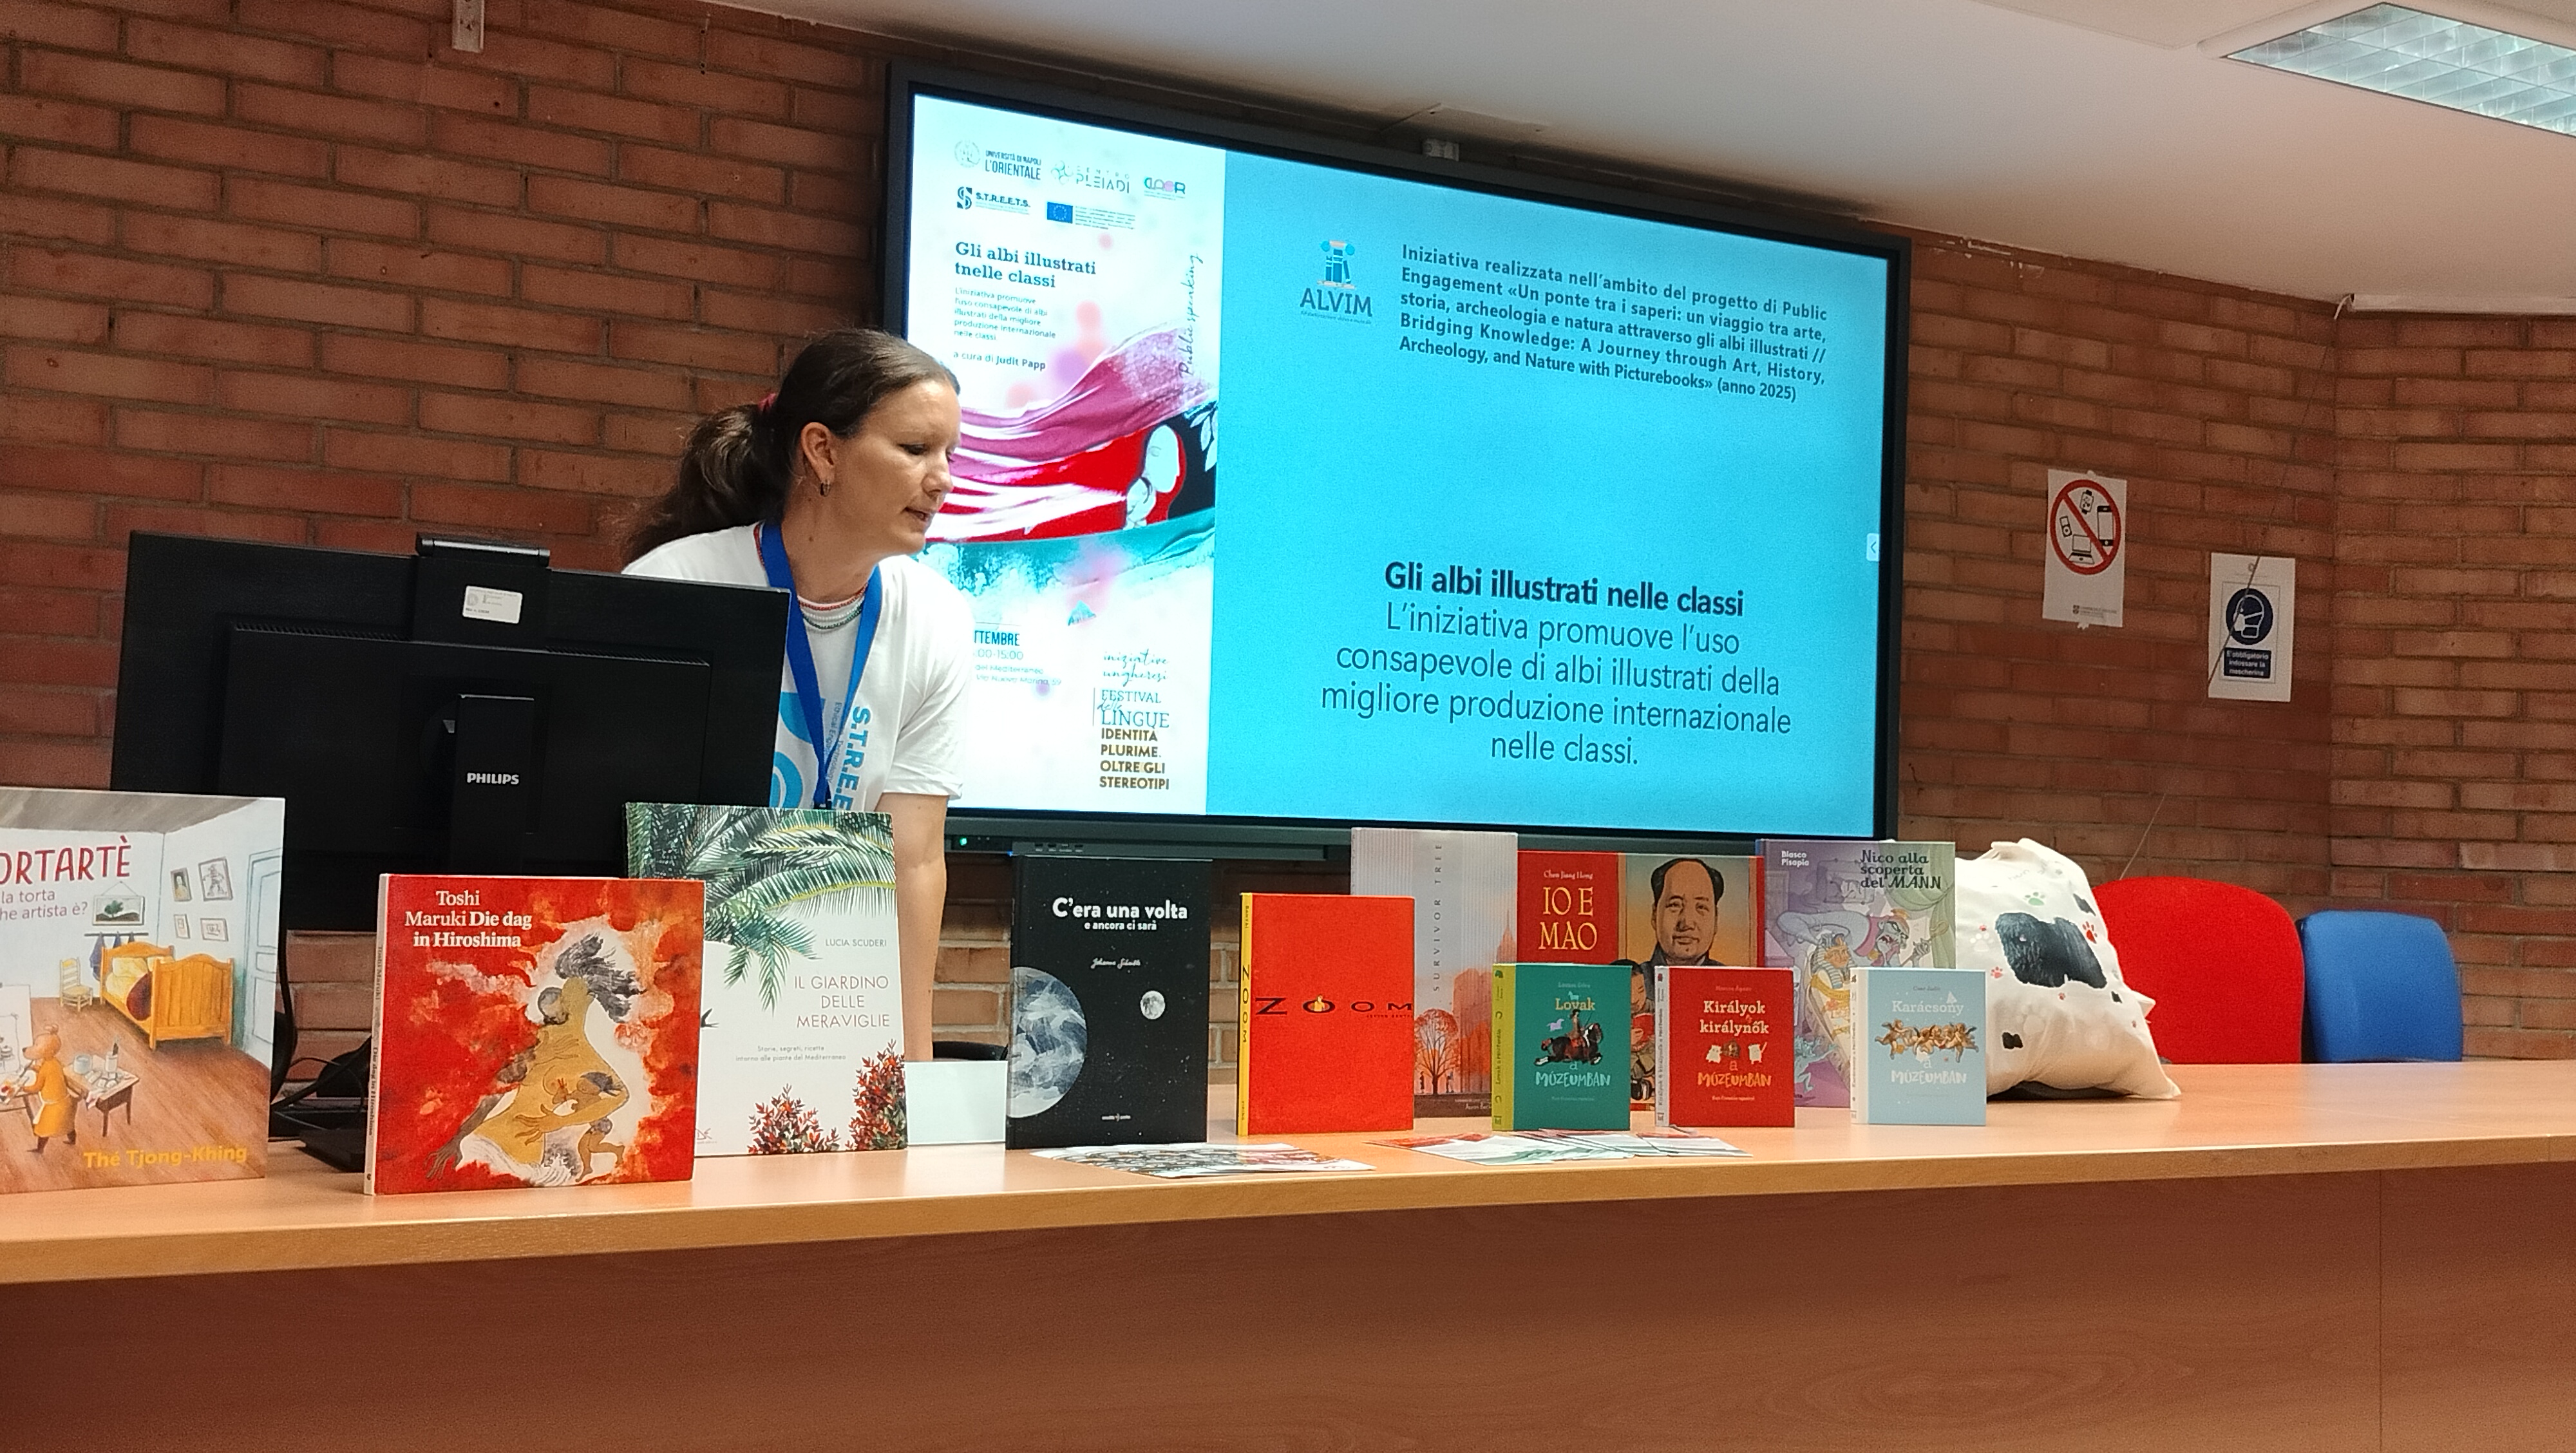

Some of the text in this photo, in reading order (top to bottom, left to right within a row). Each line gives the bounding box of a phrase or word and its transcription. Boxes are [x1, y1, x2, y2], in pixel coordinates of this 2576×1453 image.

[985, 158, 1041, 180] L'ORIENTALE
[954, 241, 1096, 275] Gli albi illustrati
[954, 261, 1056, 288] tnelle classi
[1403, 244, 1478, 270] Iniziativa
[1486, 260, 1562, 282] realizzata
[1663, 284, 1686, 300] del
[1692, 292, 1757, 310] progetto
[1763, 299, 1776, 314] di
[1783, 301, 1826, 320] Public
[1300, 287, 1372, 317] ALVIM
[1402, 267, 1502, 296] Engagement
[1545, 292, 1589, 308] ponte
[1595, 296, 1616, 312] tra
[1622, 298, 1626, 313] i
[1631, 305, 1681, 321] saperi:
[1687, 312, 1704, 324] un
[1709, 312, 1763, 334] viaggio
[1769, 321, 1788, 336] tra
[1794, 327, 1826, 343] arte,
[1401, 292, 1450, 313] storia,
[1456, 300, 1546, 326] archeologia
[1551, 316, 1560, 326] e
[1565, 317, 1613, 334] natura
[1618, 323, 1692, 343] attraverso
[1696, 332, 1714, 349] gli
[1719, 335, 1745, 351] albi
[1750, 338, 1808, 360] illustrati
[1401, 312, 1473, 339] Bridging
[1481, 323, 1575, 352] Knowledge:
[1580, 337, 1591, 352] A
[1597, 339, 1660, 365] Journey
[1665, 348, 1727, 372] through
[1732, 358, 1761, 377] Art,
[1768, 362, 1824, 385] History,
[961, 352, 982, 361] cura
[984, 354, 994, 362] di
[995, 355, 1019, 366] Judit
[1021, 357, 1046, 372] Papp
[1399, 336, 1796, 403] Archeology, and Nature with Picturebooks» (anno 2025)
[1385, 561, 1743, 616] Gli albi illustrati nelle classi
[1539, 621, 1673, 649] promuove
[1337, 647, 1779, 696] consapevole di albi illustrati della
[1101, 689, 1161, 703] FESTIVAL
[1322, 681, 1791, 734] migliore produzione internazionale
[1101, 709, 1170, 728] LINGUE
[1100, 743, 1162, 758] PLURIME.
[1492, 730, 1638, 764] nelle classi.
[1099, 759, 1166, 774] OLTRE GLI
[467, 772, 519, 784] PHILIPS
[1099, 775, 1170, 790] STEREOTIPI
[1781, 859, 1810, 867] Pisapia
[1860, 850, 1929, 864] Nico alla
[1860, 864, 1924, 879] scoperta
[1860, 876, 1941, 889] del MANN
[1, 888, 55, 904] la torta
[435, 889, 480, 906] Toshi
[1542, 886, 1593, 916] IO E
[22, 904, 67, 920] artista
[71, 901, 88, 916] è?
[1052, 896, 1188, 919] C'era una volta
[404, 909, 533, 931] Maruki Die dag
[1092, 922, 1125, 930] ancora
[1126, 918, 1135, 930] ci
[1137, 919, 1157, 931] sarà
[412, 931, 522, 948] in Hiroshima
[824, 938, 887, 947] LUCIA SCUDERI
[1537, 920, 1597, 950] MAO
[1433, 899, 1441, 992] SURVIVOR
[794, 974, 889, 990] IL GIARDINO
[820, 994, 865, 1009] DELLE
[1555, 998, 1595, 1011] Lovak
[1703, 999, 1766, 1018] Királyok
[1891, 999, 1964, 1016] Karácsony
[796, 1013, 890, 1029] MERAVIGLIE
[1699, 1019, 1769, 1036] királynők
[1729, 1060, 1738, 1071] a
[1535, 1070, 1611, 1088] MÚZEUMBAN
[1697, 1070, 1772, 1088] MÚZEUMBAN
[1891, 1069, 1967, 1085] MÚZEUMBAN
[126, 1144, 247, 1169] Tjong-Khing
